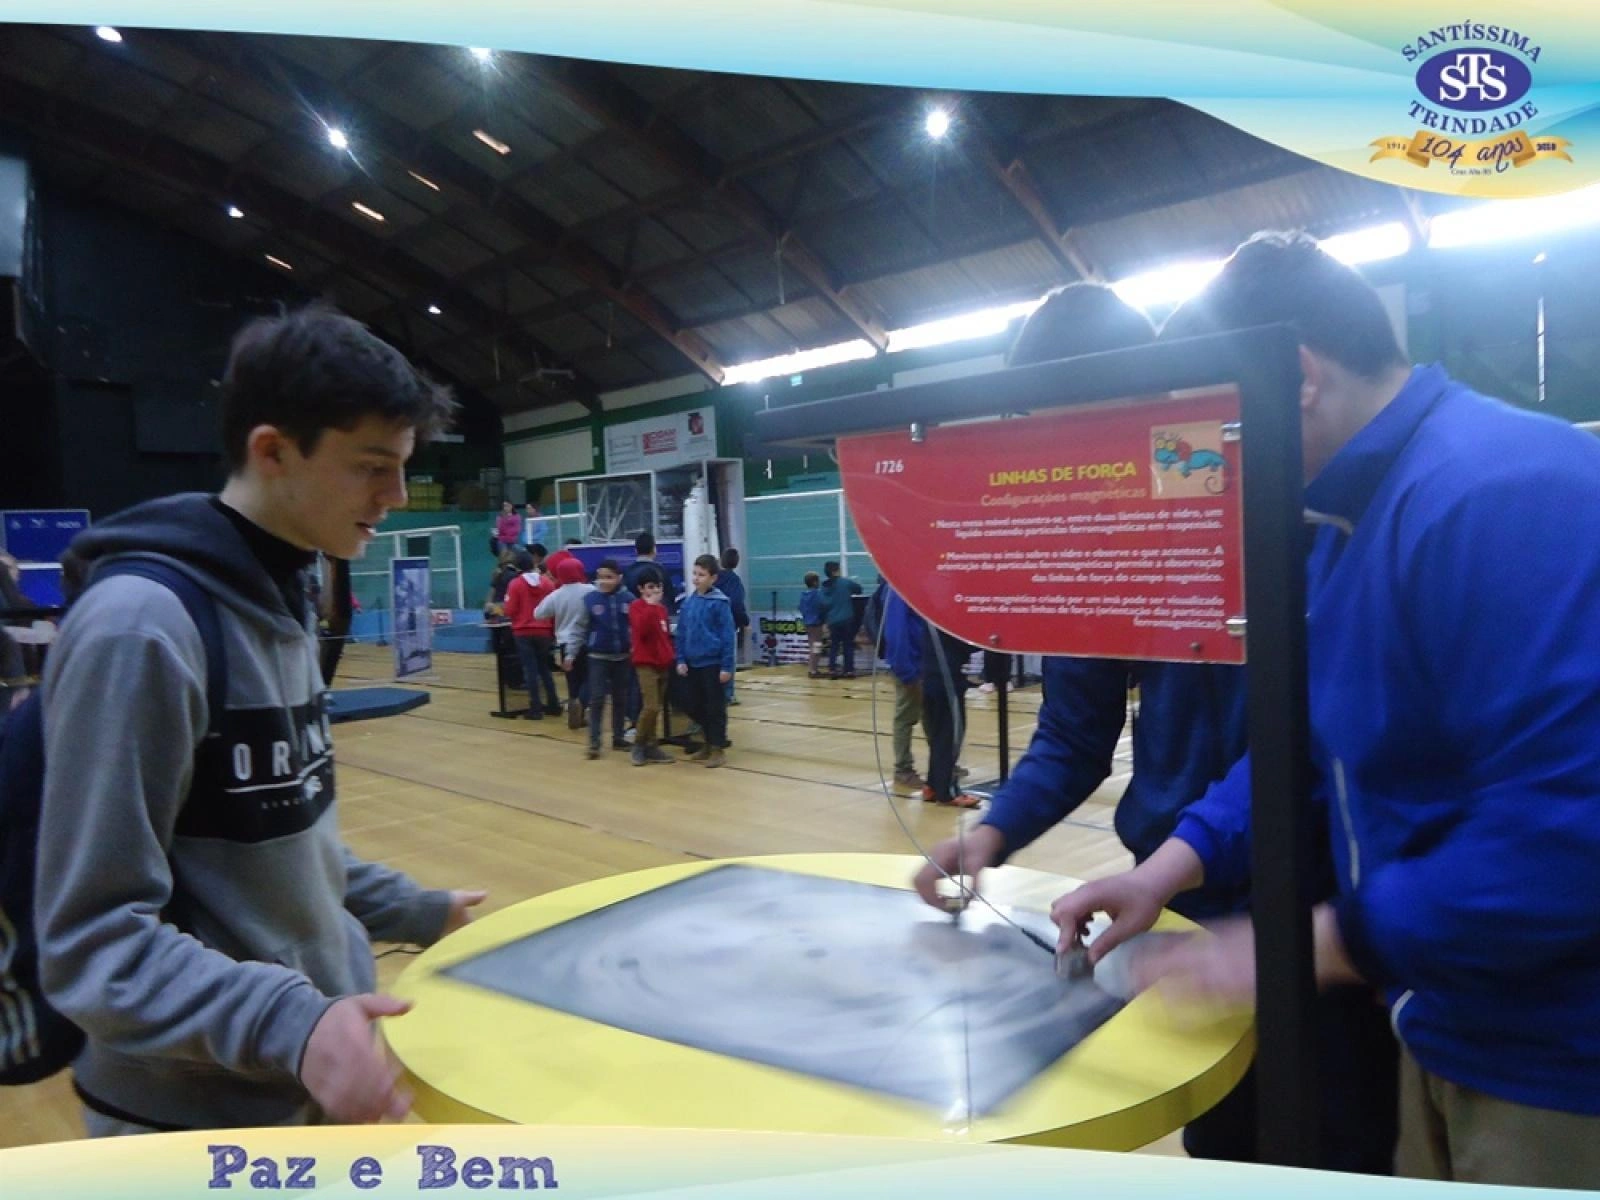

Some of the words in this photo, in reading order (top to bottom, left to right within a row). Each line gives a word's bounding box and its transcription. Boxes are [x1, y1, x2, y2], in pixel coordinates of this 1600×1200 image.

[875, 459, 905, 474] 1726
[990, 468, 1048, 486] LINHAS
[1052, 466, 1073, 481] DE
[1078, 461, 1137, 481] FORÇA
